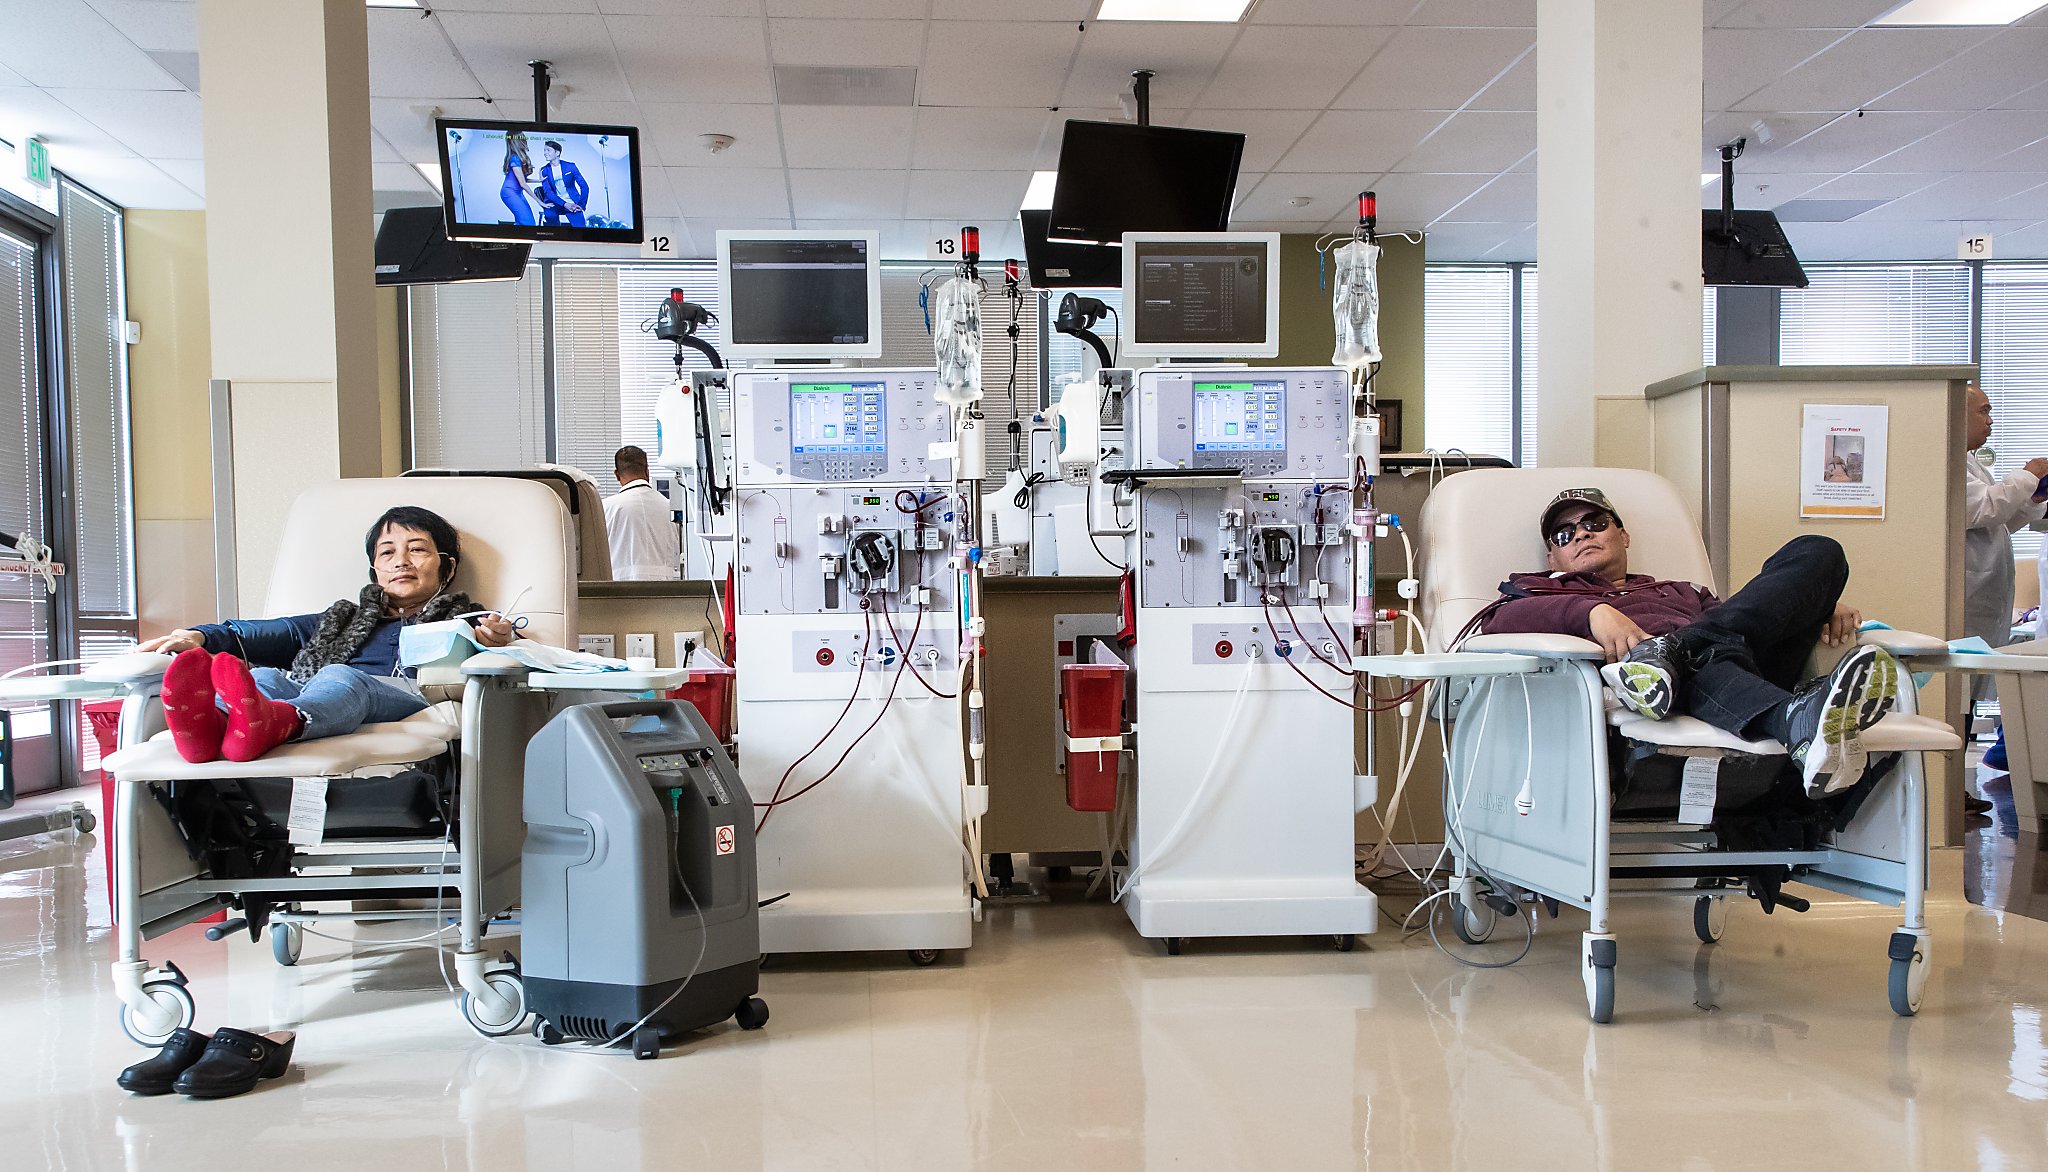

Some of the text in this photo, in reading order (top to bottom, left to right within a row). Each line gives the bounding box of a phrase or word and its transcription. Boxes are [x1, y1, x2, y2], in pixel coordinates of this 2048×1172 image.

[30, 142, 49, 184] EXIT
[650, 236, 670, 252] 12
[935, 239, 955, 255] 13
[1966, 238, 1985, 254] 15
